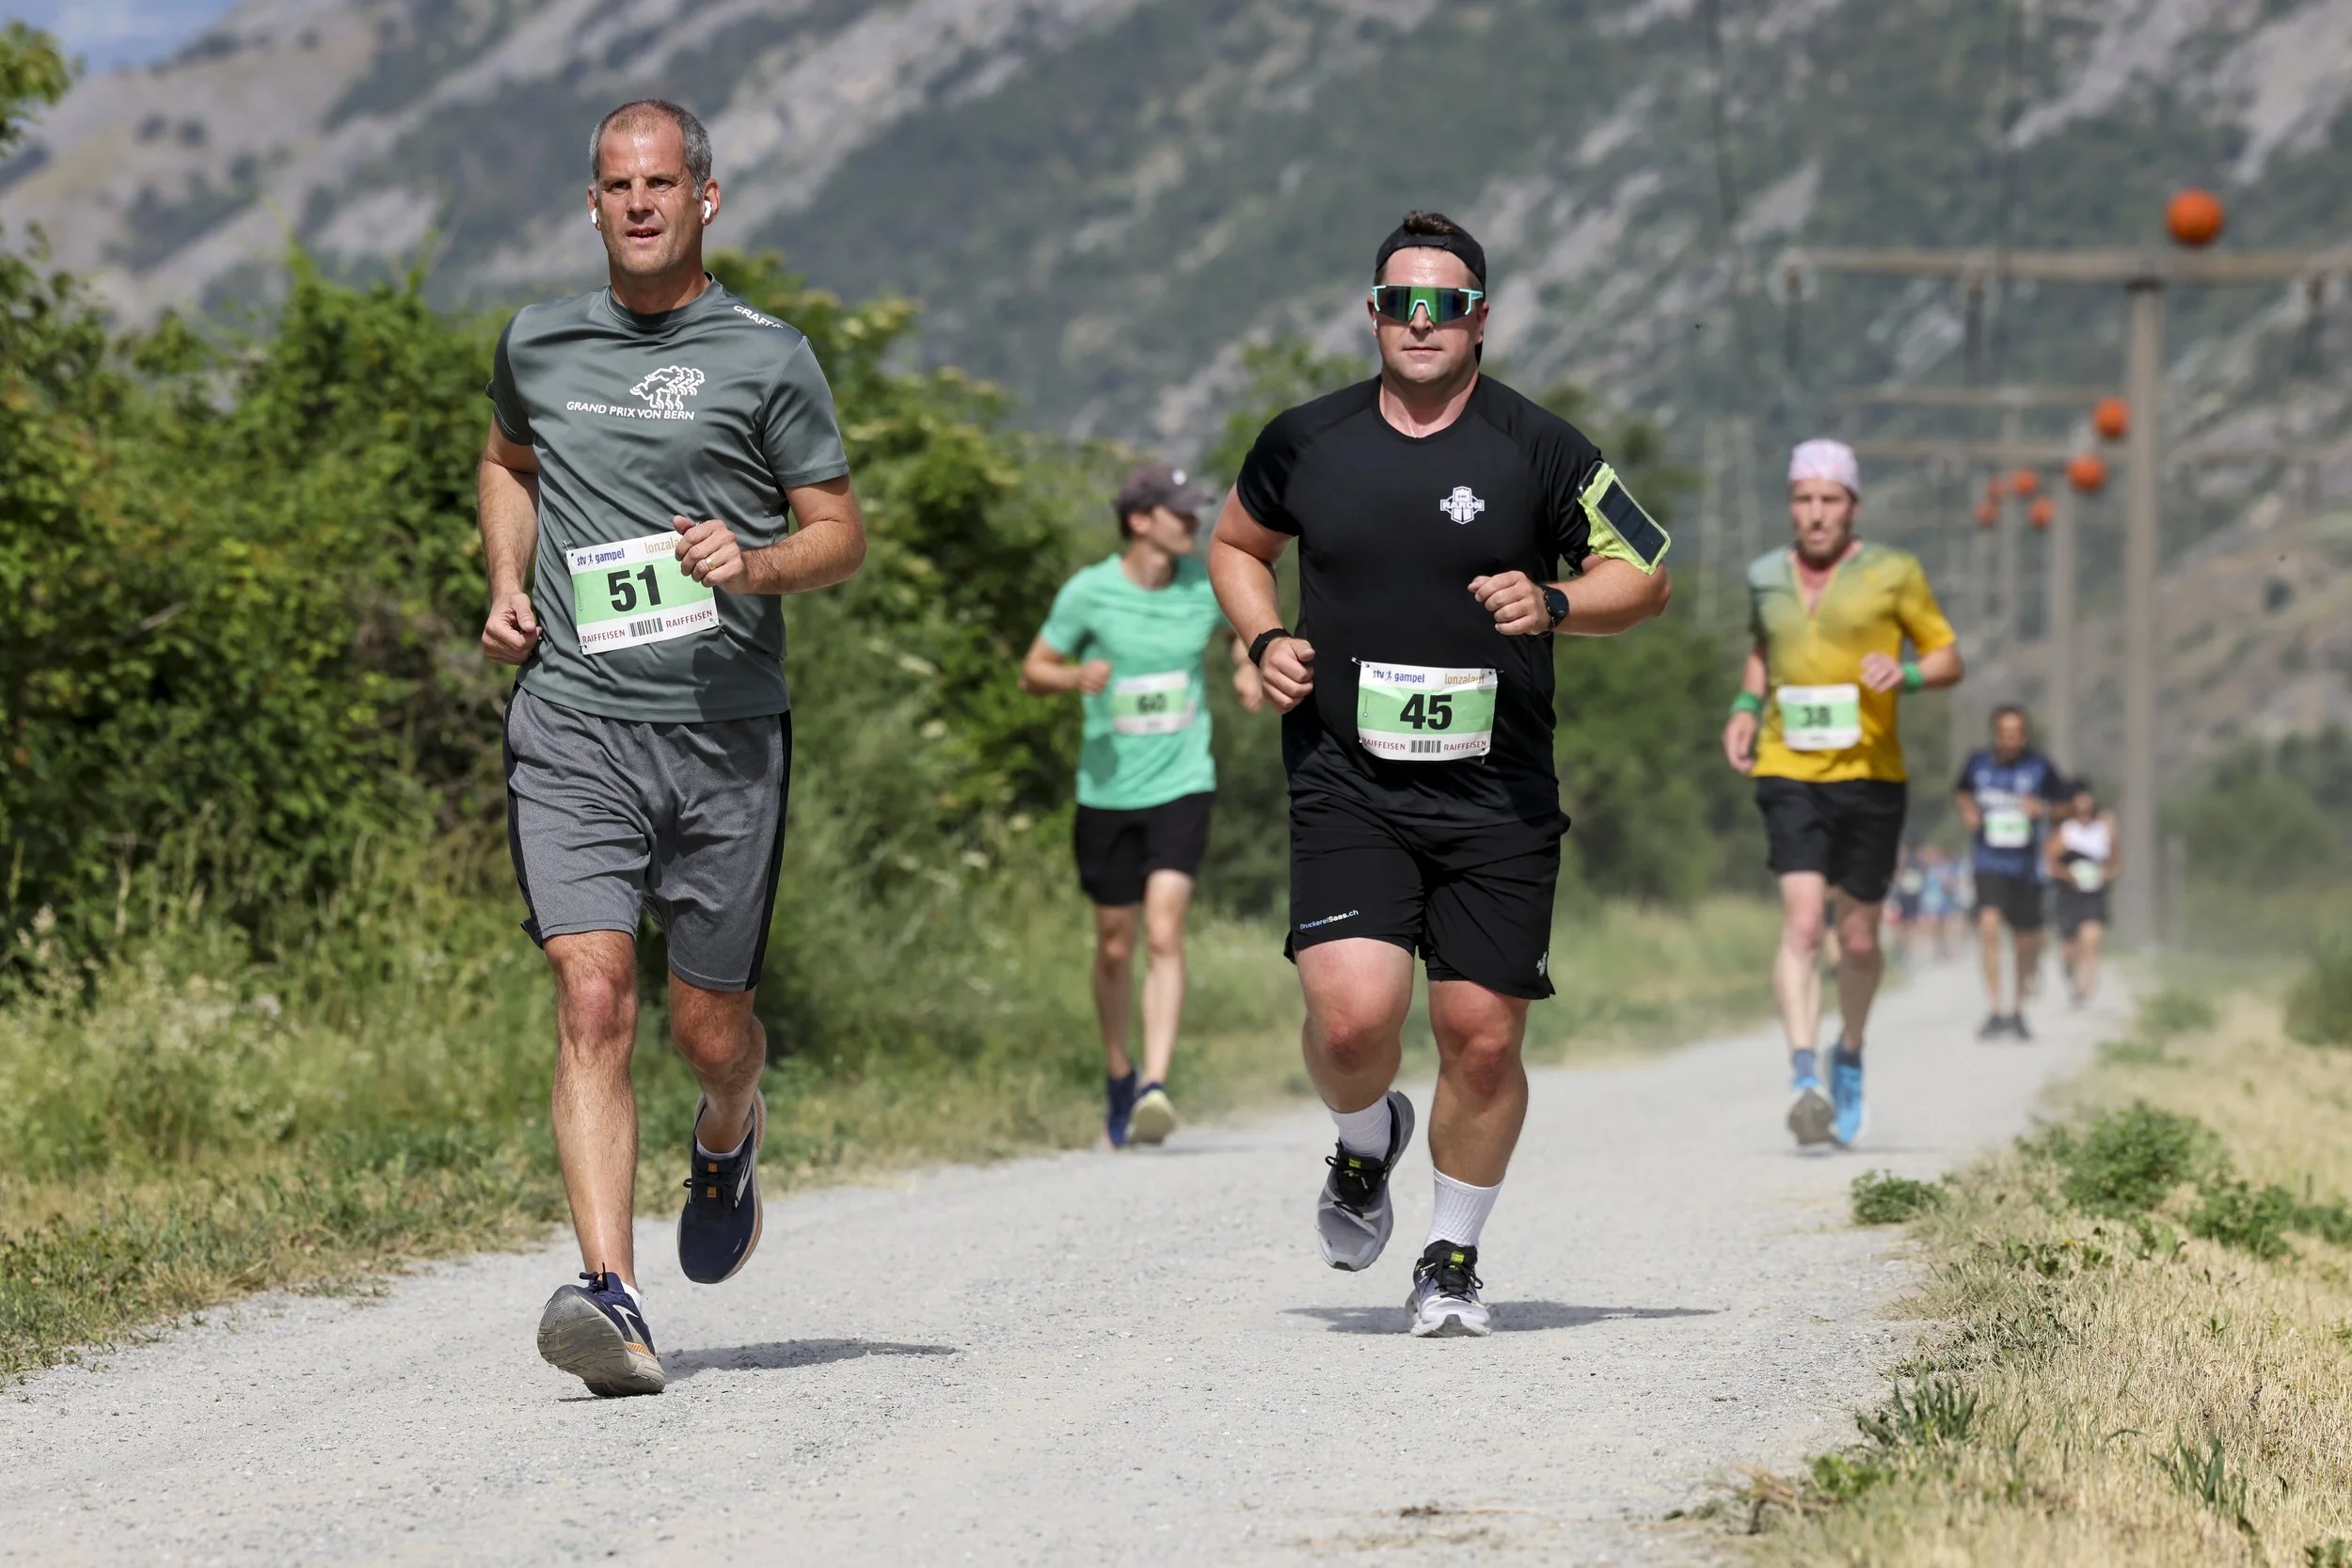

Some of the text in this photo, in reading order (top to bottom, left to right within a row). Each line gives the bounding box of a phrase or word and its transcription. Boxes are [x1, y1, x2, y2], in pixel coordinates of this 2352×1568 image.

[734, 305, 774, 326] CRAFT
[566, 401, 695, 420] GRAND PRIX VON BERN
[1442, 500, 1483, 509] RARON
[577, 547, 626, 566] stv gampel
[607, 564, 662, 612] 51
[665, 610, 713, 628] RAIFFEISEN
[581, 629, 626, 643] RAIFFEISEN
[1373, 670, 1425, 684] stv gampel
[1136, 691, 1168, 715] 60
[1400, 693, 1453, 730] 45
[1361, 737, 1406, 751] RAIFFEISEN
[1443, 739, 1486, 752] RAIFFEISEN
[1299, 910, 1359, 930] DruckereiSaas.ch
